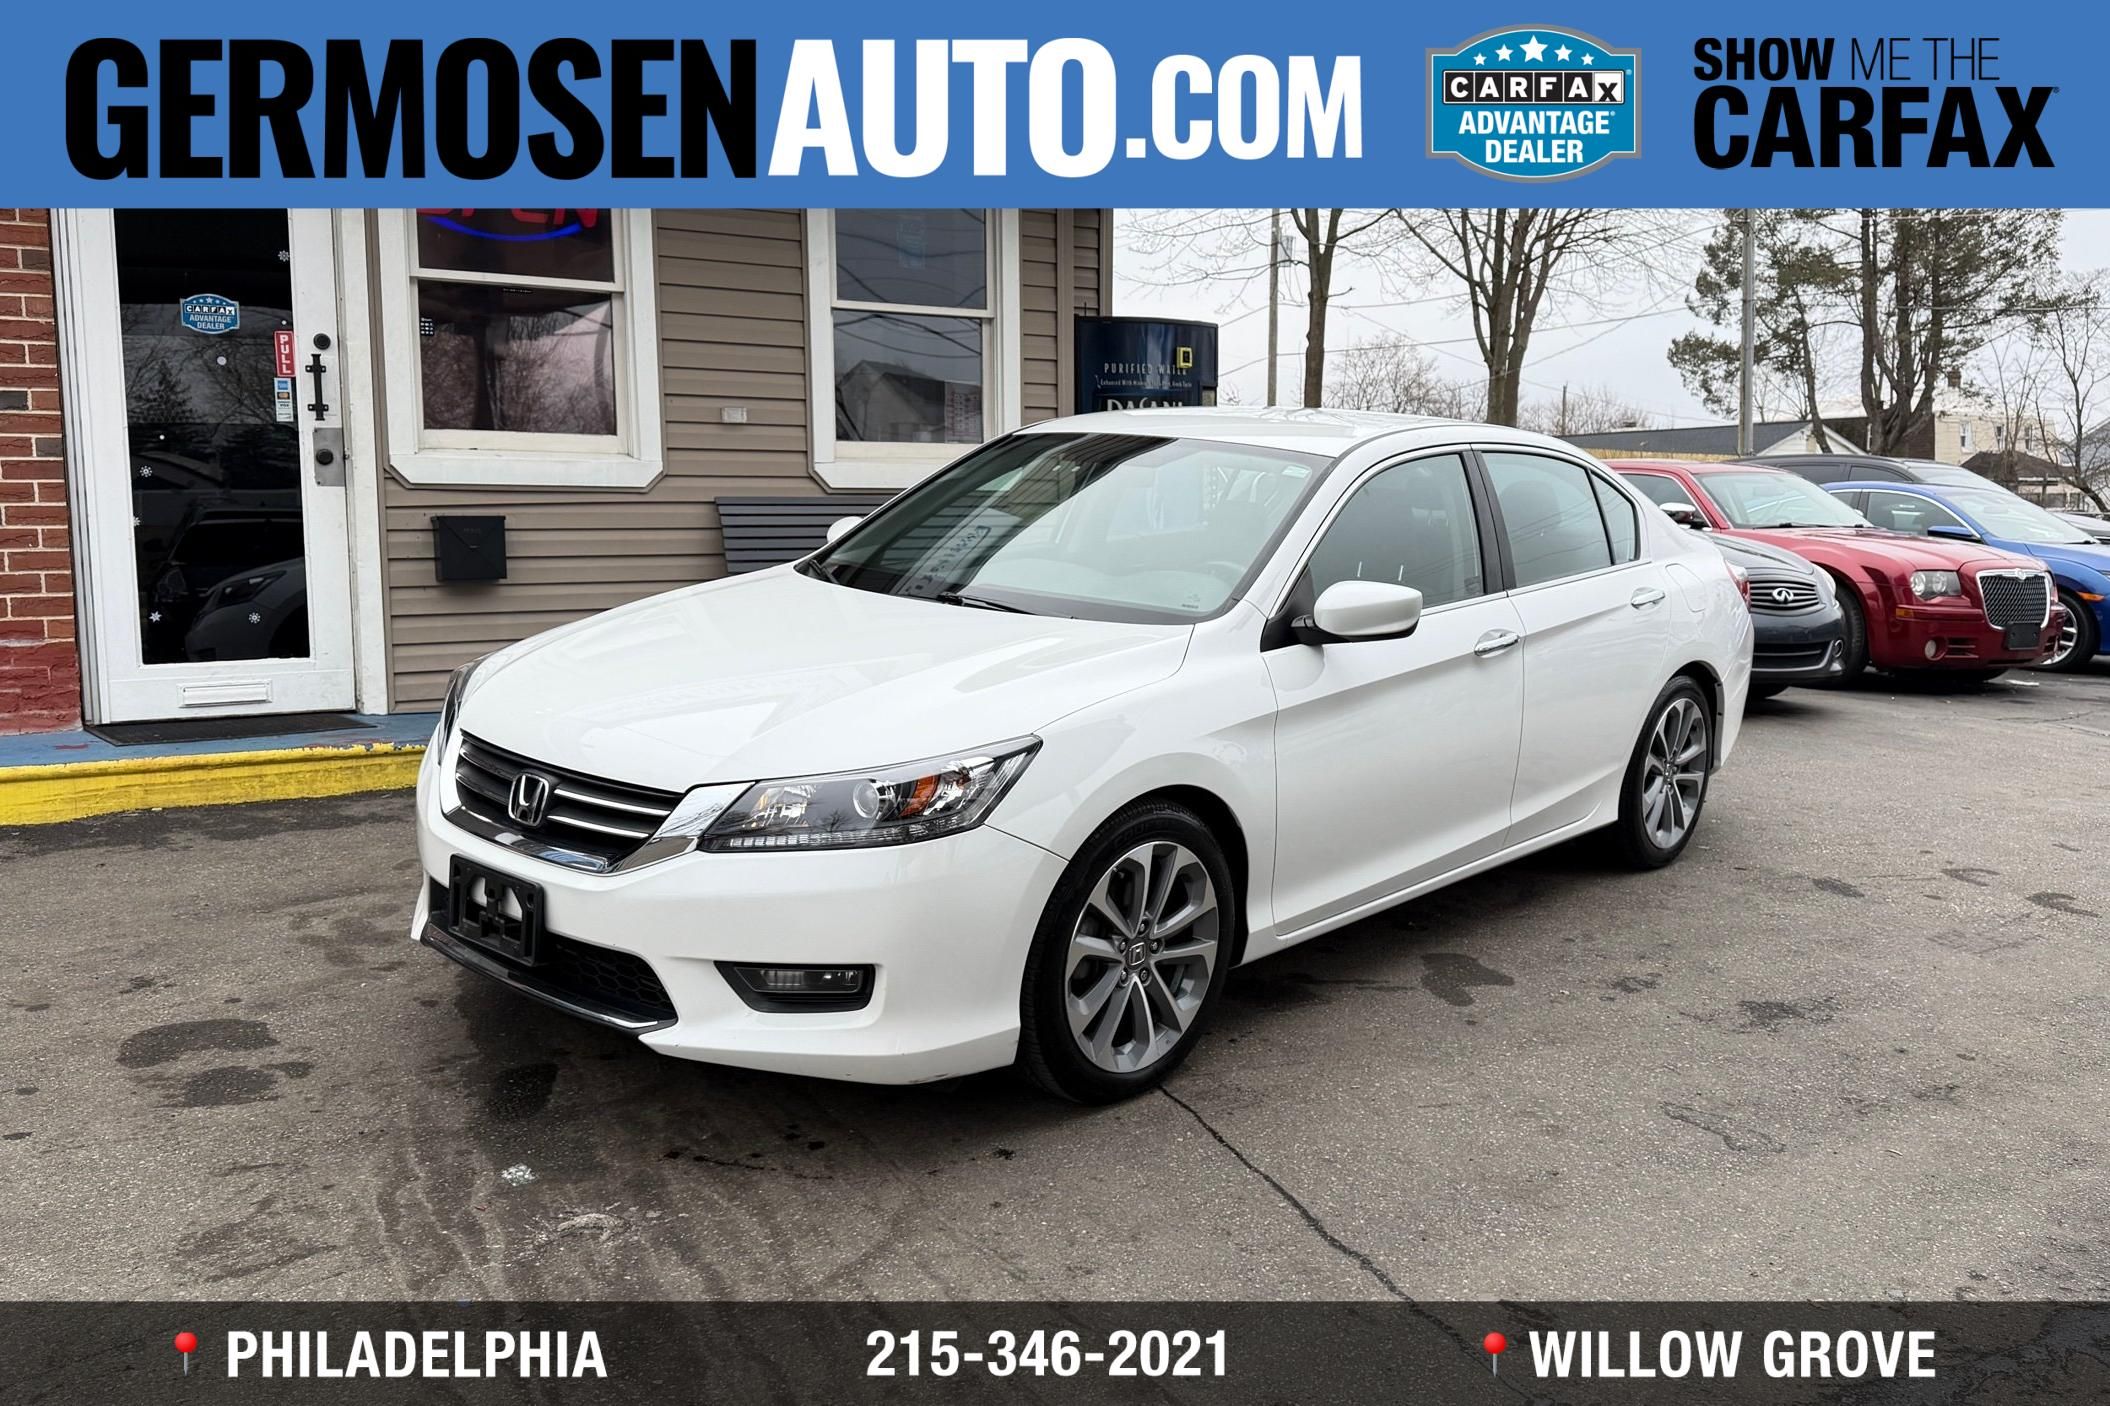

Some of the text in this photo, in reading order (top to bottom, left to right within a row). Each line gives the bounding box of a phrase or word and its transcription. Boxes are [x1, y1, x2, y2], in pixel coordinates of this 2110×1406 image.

[186, 305, 235, 315] CARFAX
[190, 314, 231, 324] ADVANTAGE
[197, 322, 225, 330] DEALER
[279, 334, 292, 374] PULL
[1104, 362, 1153, 374] PURIFIED
